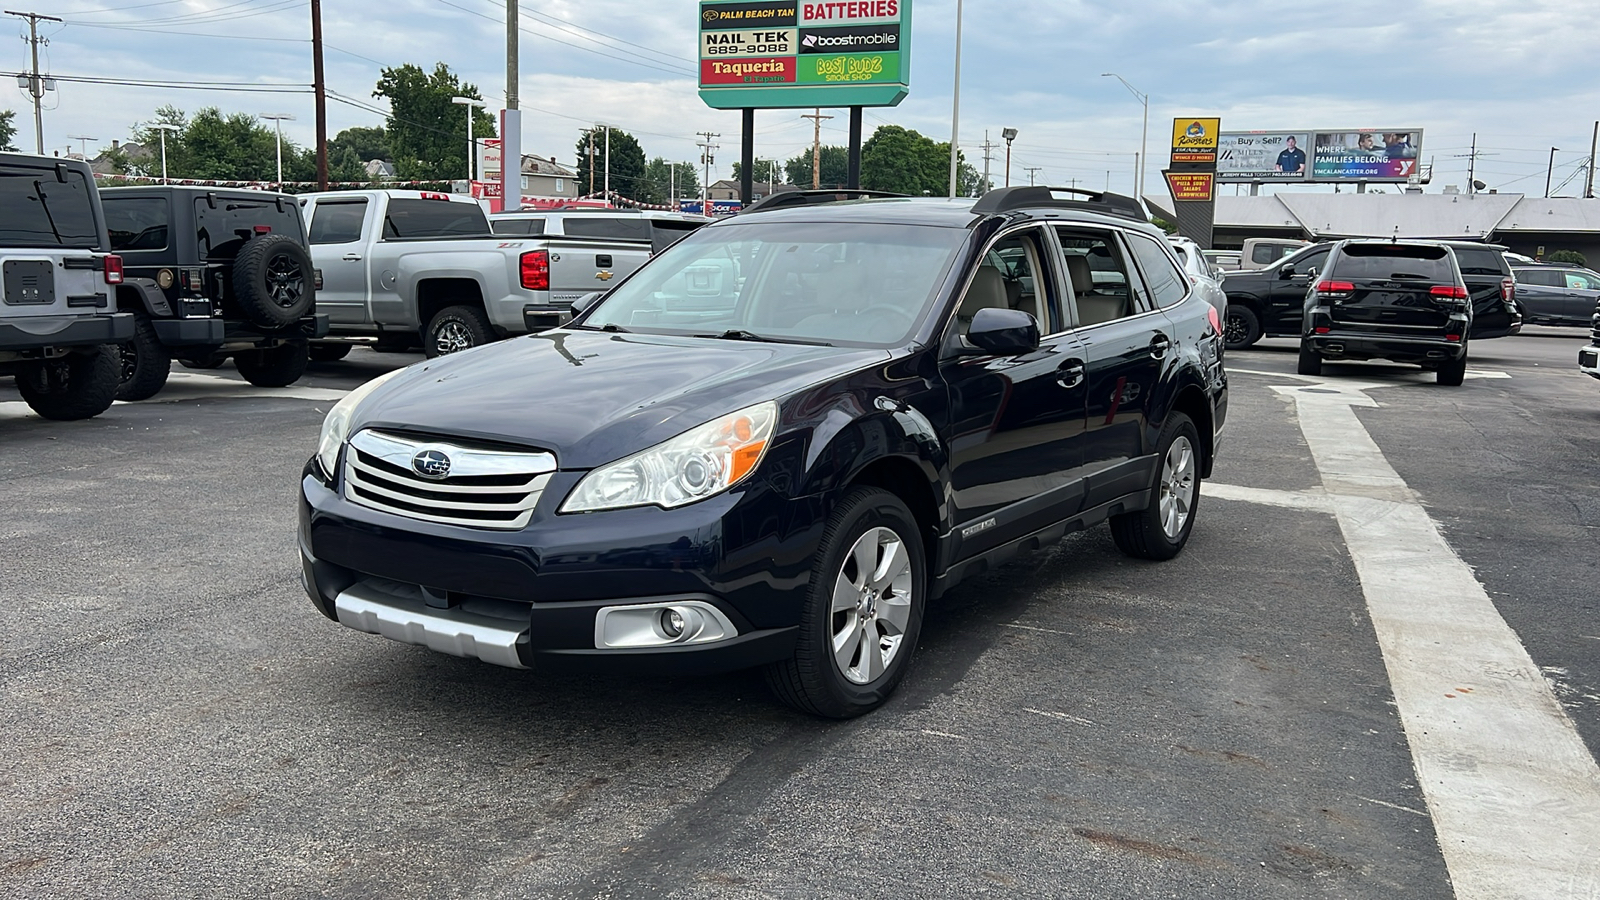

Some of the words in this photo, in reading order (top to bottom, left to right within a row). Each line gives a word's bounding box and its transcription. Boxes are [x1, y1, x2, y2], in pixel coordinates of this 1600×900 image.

[720, 11, 743, 19] PALM
[745, 9, 775, 18] BEACH
[777, 8, 795, 17] TAN
[803, 0, 898, 20] BATTERIES
[706, 33, 746, 45] NAIL
[752, 31, 789, 43] TEK
[708, 44, 788, 55] 689-9088
[712, 59, 785, 76] Taquería
[825, 74, 850, 82] SMOKE
[851, 73, 872, 81] SHOP
[1237, 137, 1254, 146] Buy
[1262, 137, 1282, 145] Sell?
[1315, 156, 1353, 164] FAMILIES
[1354, 156, 1391, 164] BELONG.
